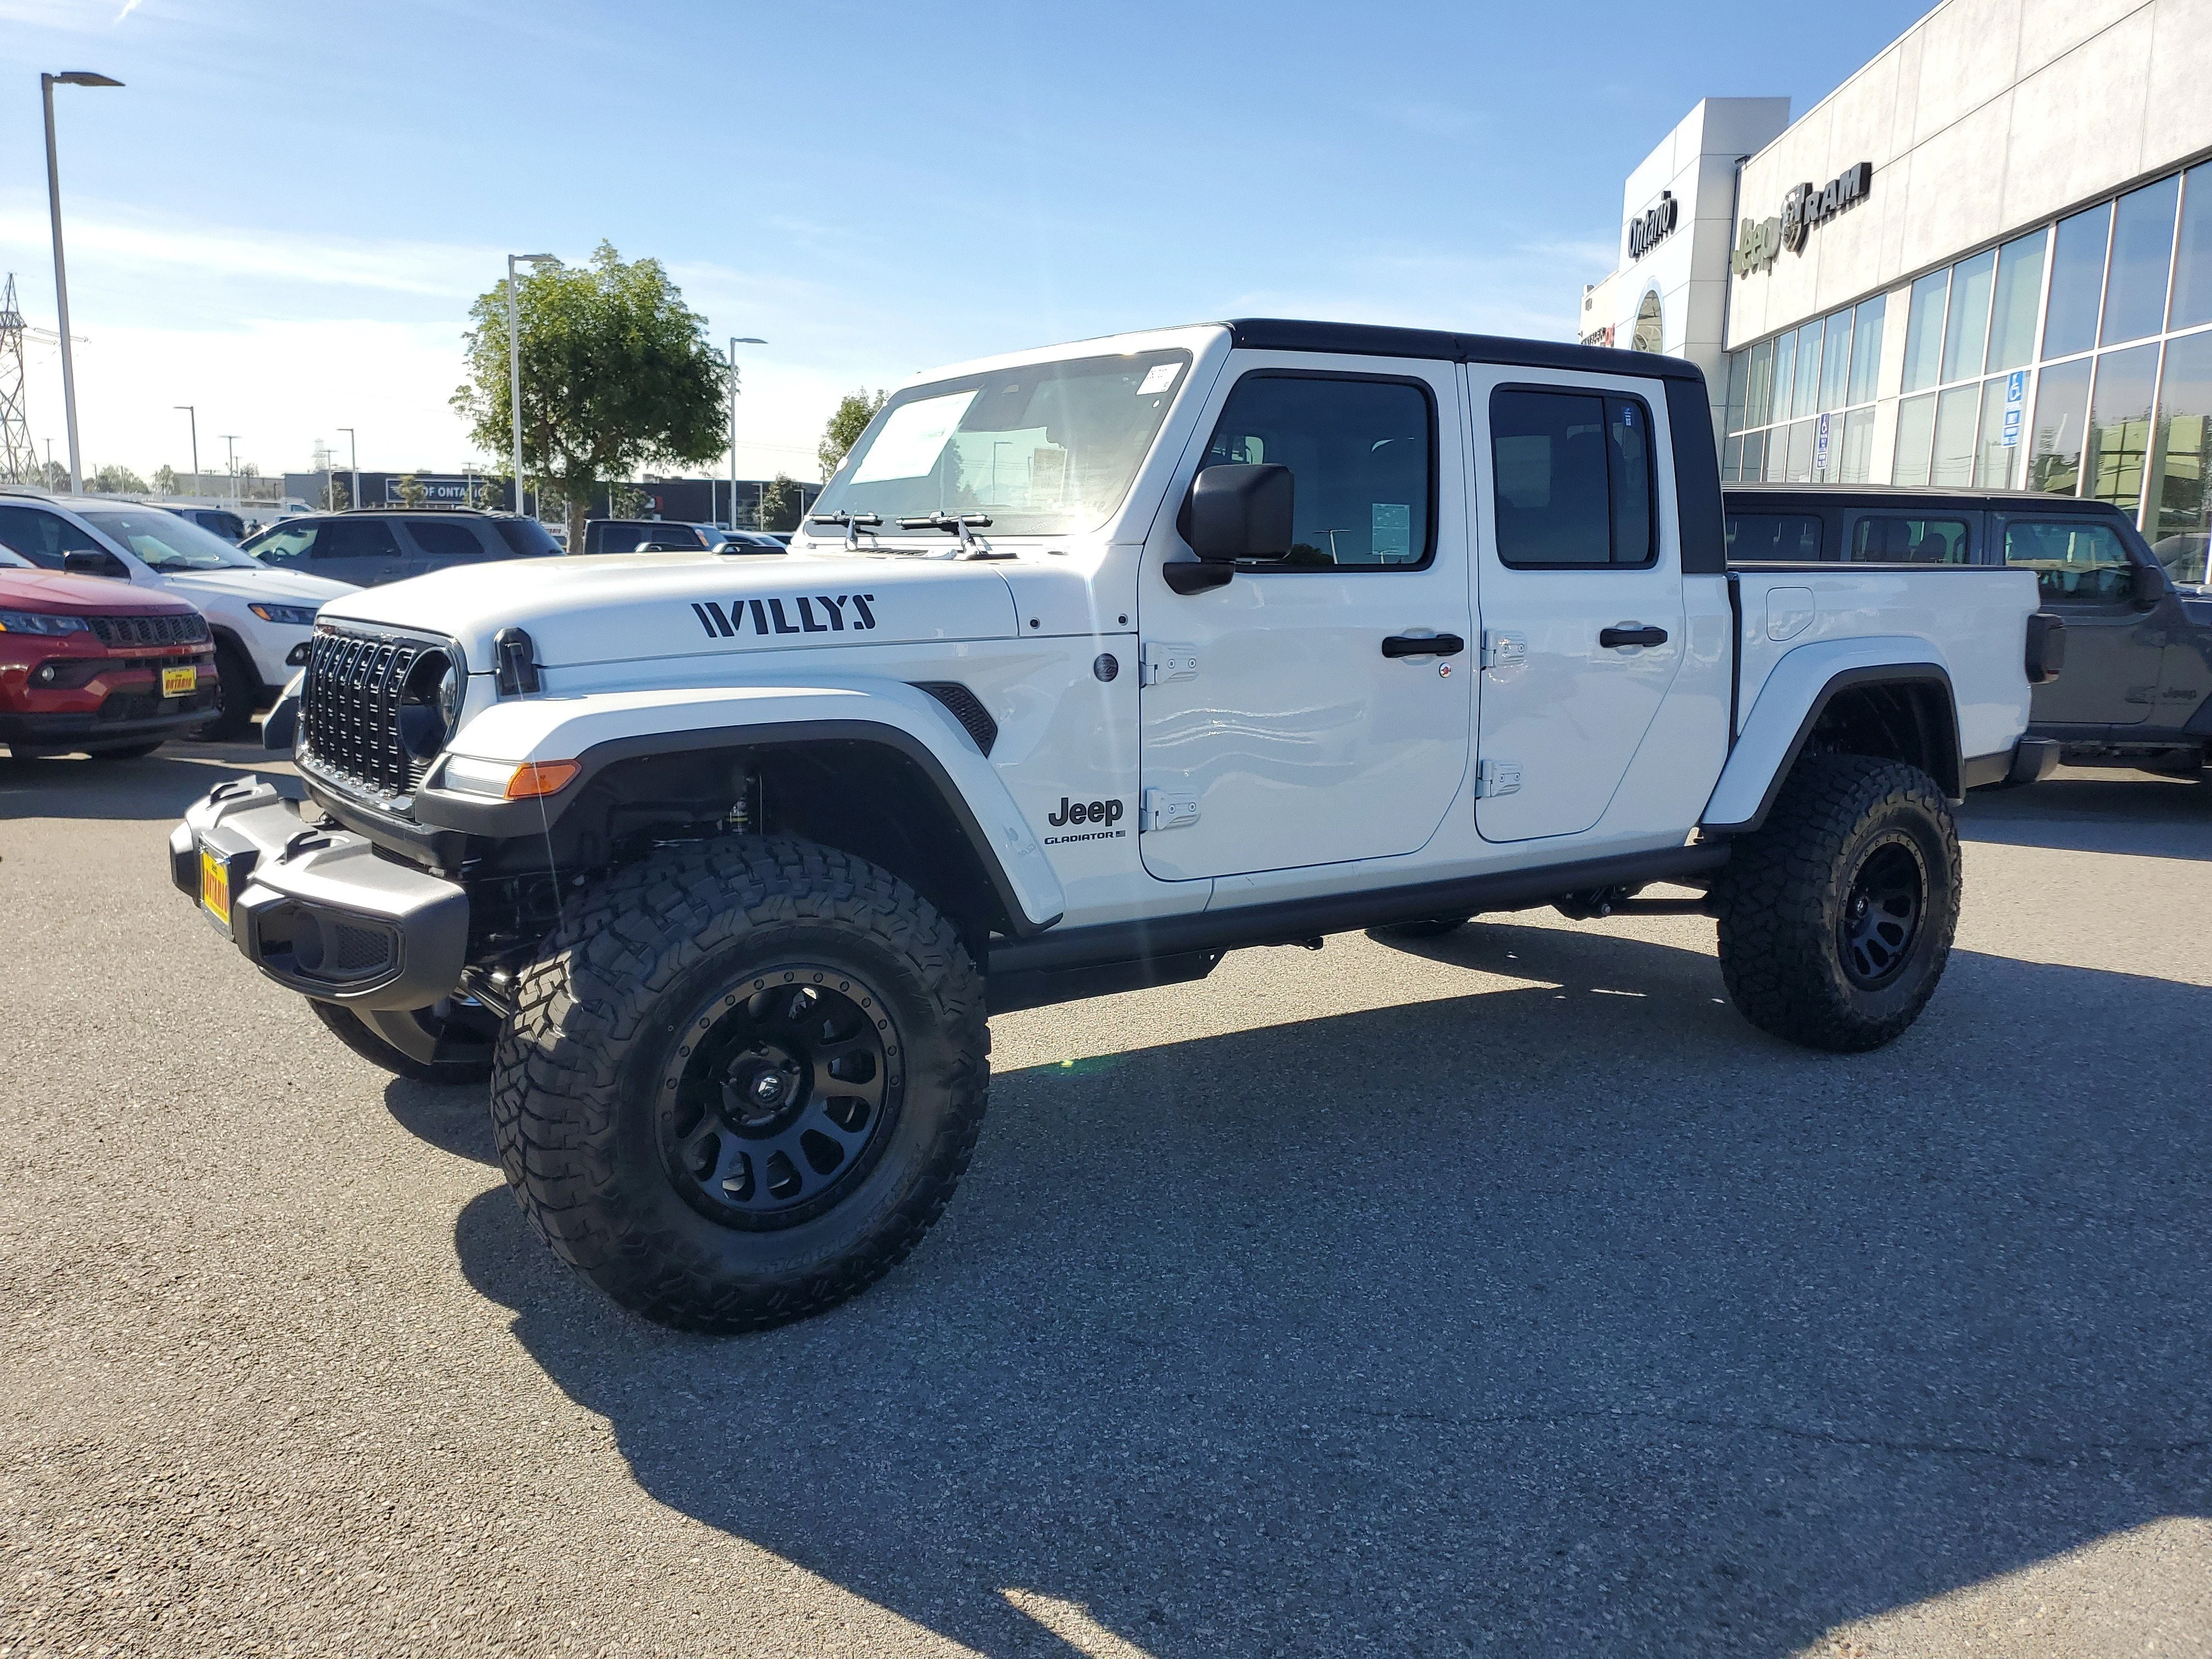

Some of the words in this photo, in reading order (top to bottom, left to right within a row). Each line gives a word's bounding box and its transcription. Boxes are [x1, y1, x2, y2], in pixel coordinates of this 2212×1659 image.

[1804, 162, 1872, 226] RAM
[1628, 191, 1677, 258] Ontario
[1732, 217, 1781, 274] Jeep
[437, 486, 484, 498] ONTAIO
[691, 594, 876, 637] WILLYS
[1048, 797, 1123, 827] Jeep
[1044, 832, 1114, 844] GLADIATOR
